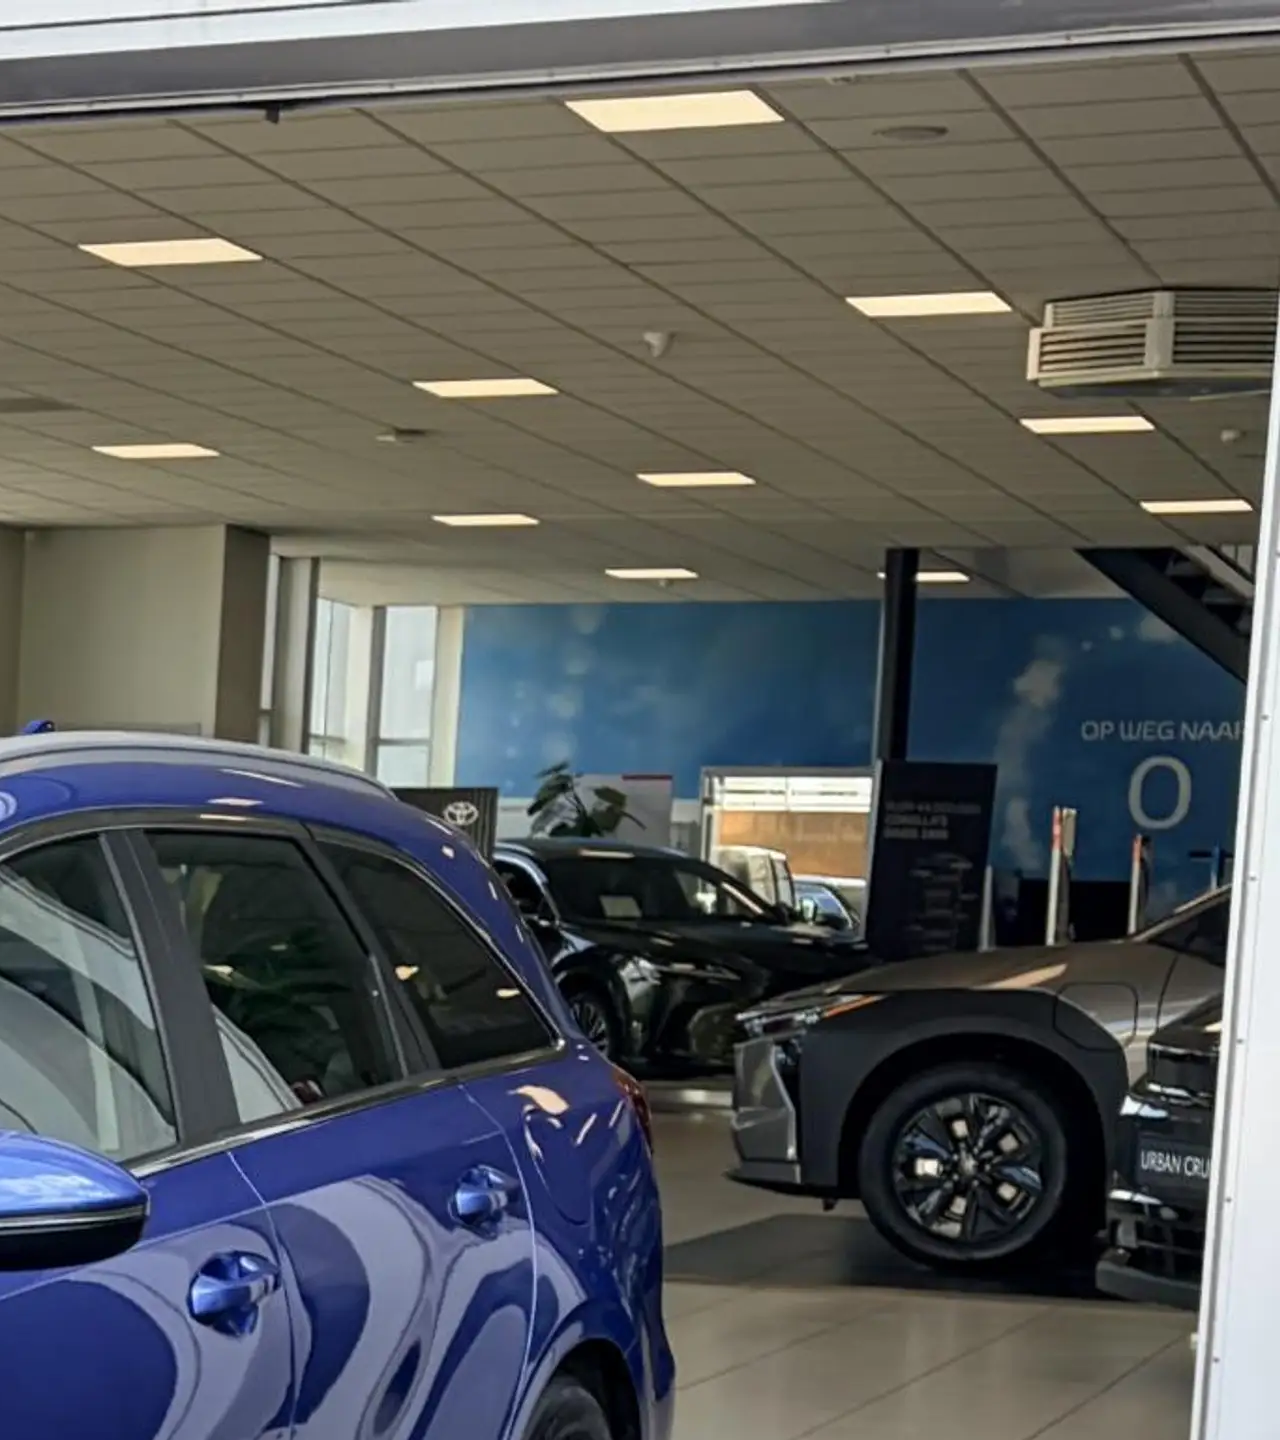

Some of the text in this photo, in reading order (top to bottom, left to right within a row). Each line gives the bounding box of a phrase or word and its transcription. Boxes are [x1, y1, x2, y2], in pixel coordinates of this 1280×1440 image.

[1081, 720, 1114, 741] OP
[1119, 720, 1175, 741] WEG
[1140, 1150, 1182, 1174] URBAN
